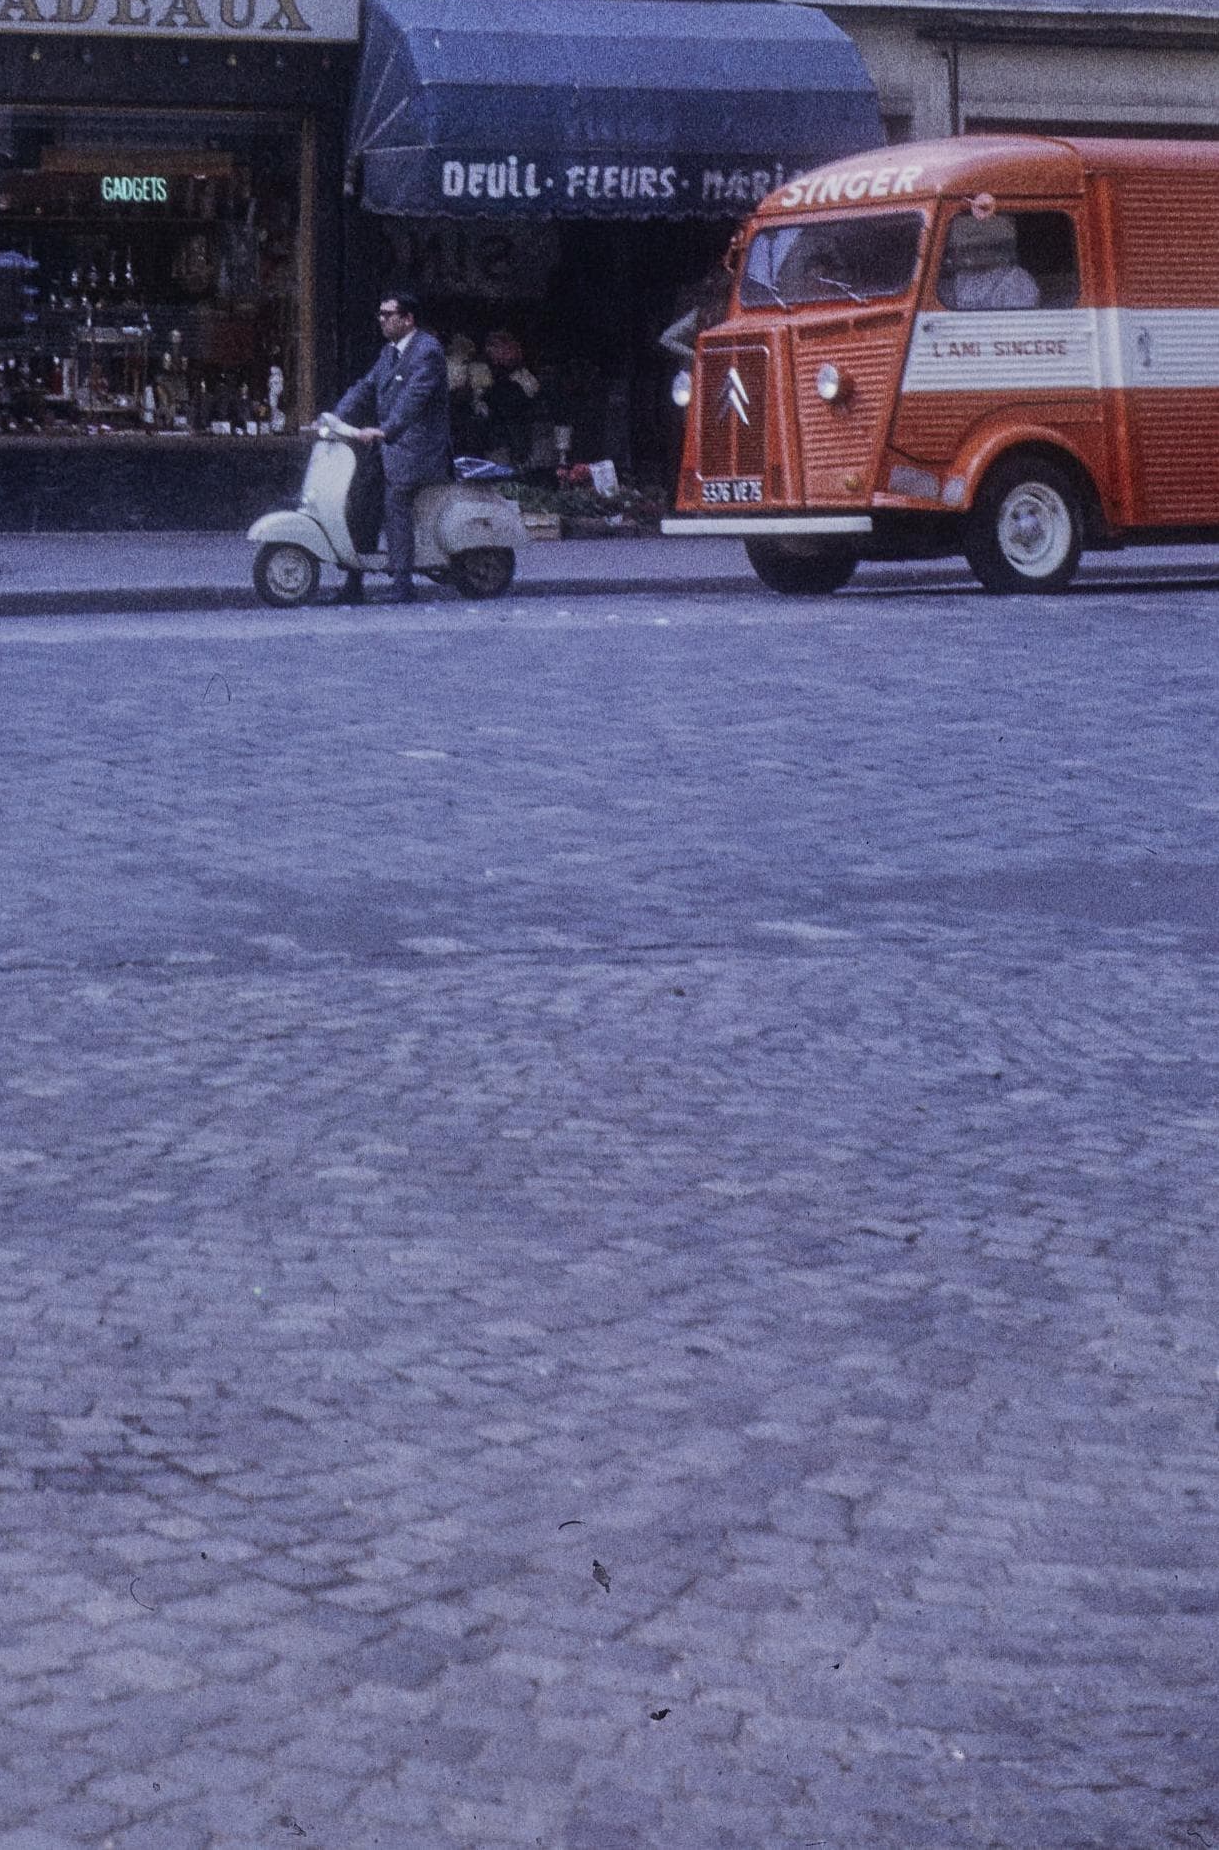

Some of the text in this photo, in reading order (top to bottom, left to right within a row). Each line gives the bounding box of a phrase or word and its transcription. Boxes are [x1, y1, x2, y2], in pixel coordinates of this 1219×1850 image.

[101, 176, 168, 202] GADGETS
[566, 164, 677, 198] FLEURS
[781, 165, 924, 208] SINGER
[993, 339, 1067, 357] SINCERE
